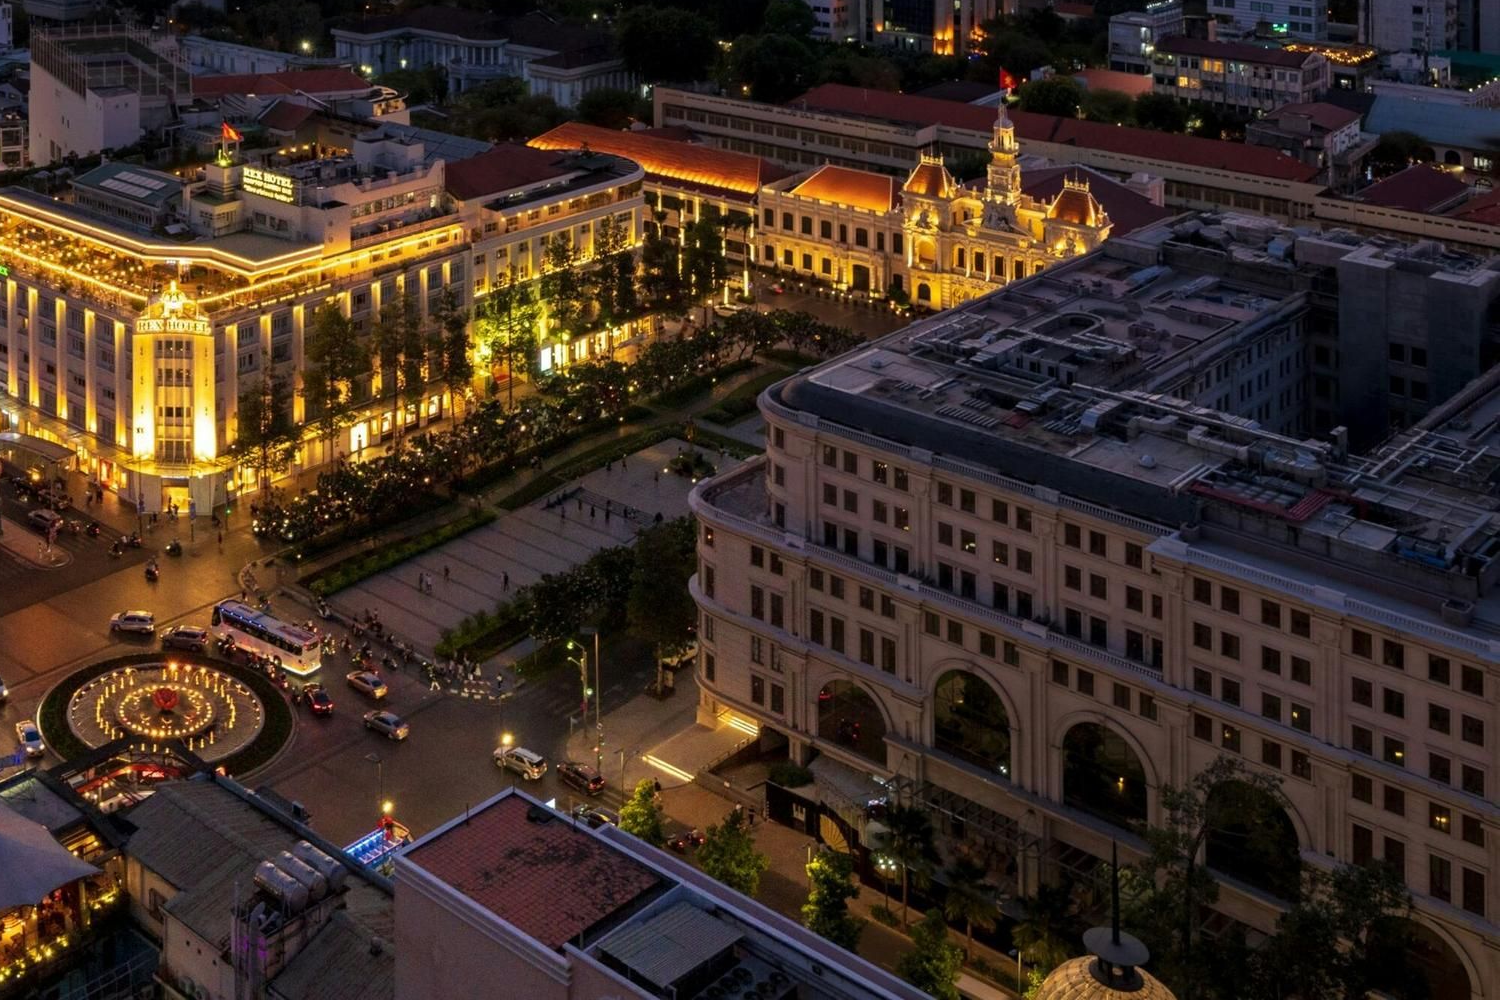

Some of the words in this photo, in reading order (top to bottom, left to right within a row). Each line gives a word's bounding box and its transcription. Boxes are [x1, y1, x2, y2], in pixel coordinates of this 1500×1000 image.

[263, 172, 293, 189] HOTEL
[137, 319, 164, 333] REX
[166, 319, 212, 335] HOTEL
